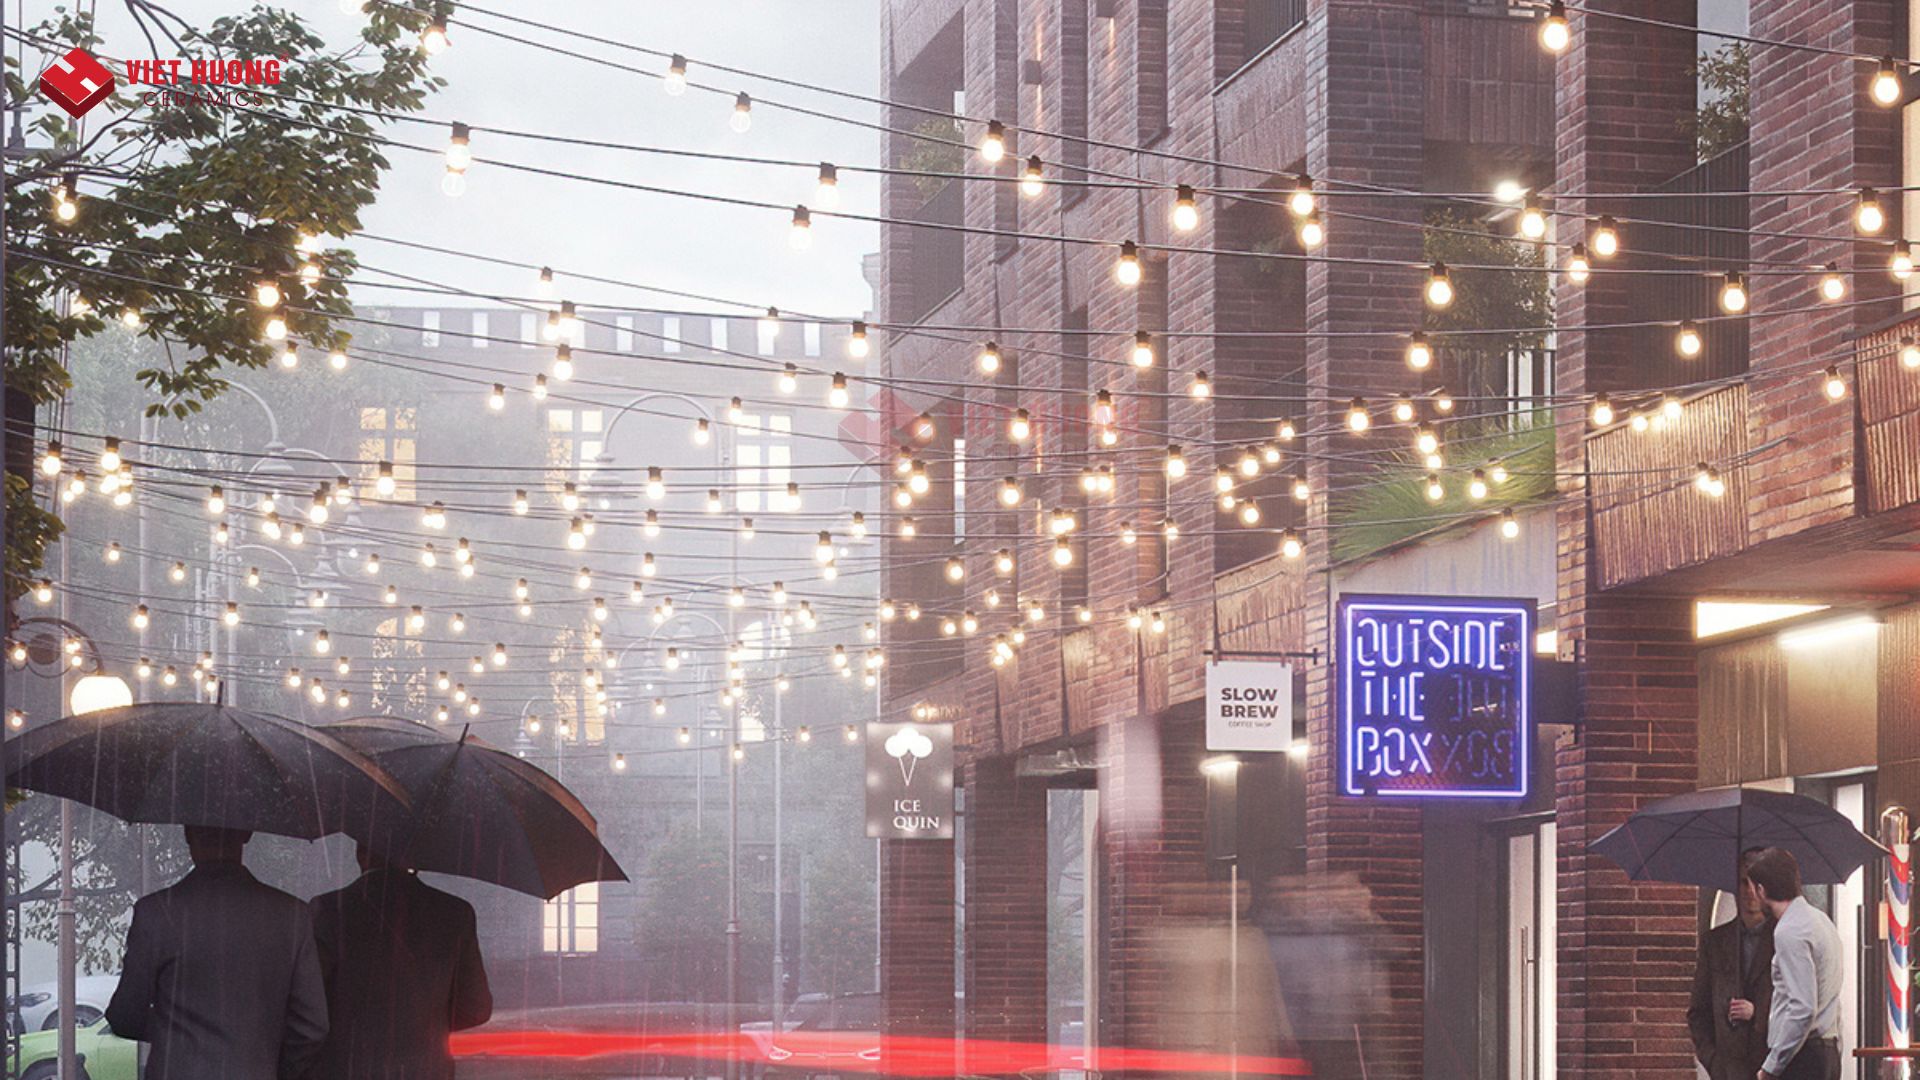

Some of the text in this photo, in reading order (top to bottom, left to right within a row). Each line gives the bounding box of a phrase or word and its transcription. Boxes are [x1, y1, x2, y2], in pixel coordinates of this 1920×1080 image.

[1357, 617, 1505, 670] OUTSIDE
[1221, 687, 1278, 702] SLOW
[1360, 671, 1425, 721] THE
[1221, 704, 1279, 719] BREW
[1357, 726, 1433, 777] BOX
[893, 799, 921, 813] ICE
[893, 815, 940, 833] QUIN
